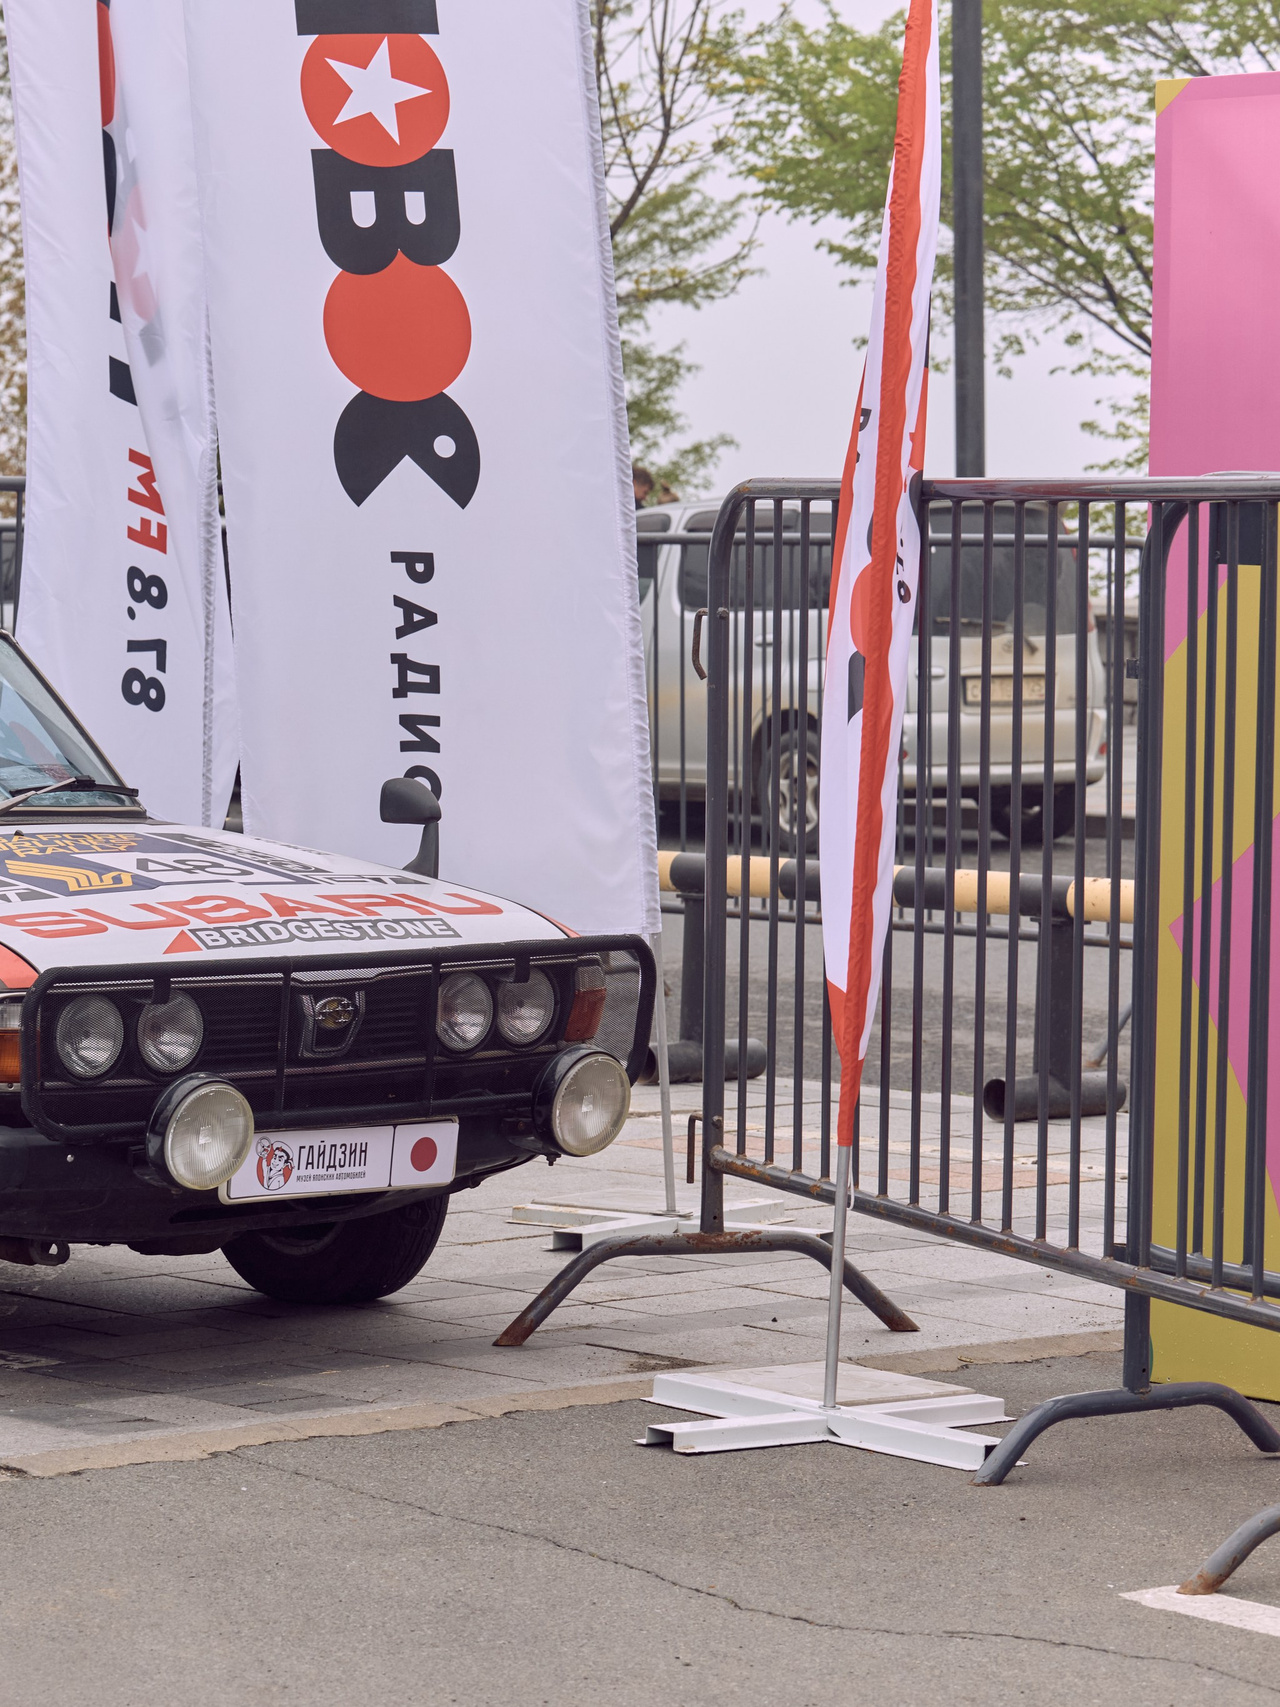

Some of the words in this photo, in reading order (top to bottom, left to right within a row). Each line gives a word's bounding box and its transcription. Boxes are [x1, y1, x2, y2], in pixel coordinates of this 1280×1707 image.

[15, 845, 128, 858] RALLY
[136, 858, 254, 876] 48
[203, 919, 454, 947] BRIDGESTONE
[297, 1140, 368, 1172] ГАЙДЗИН
